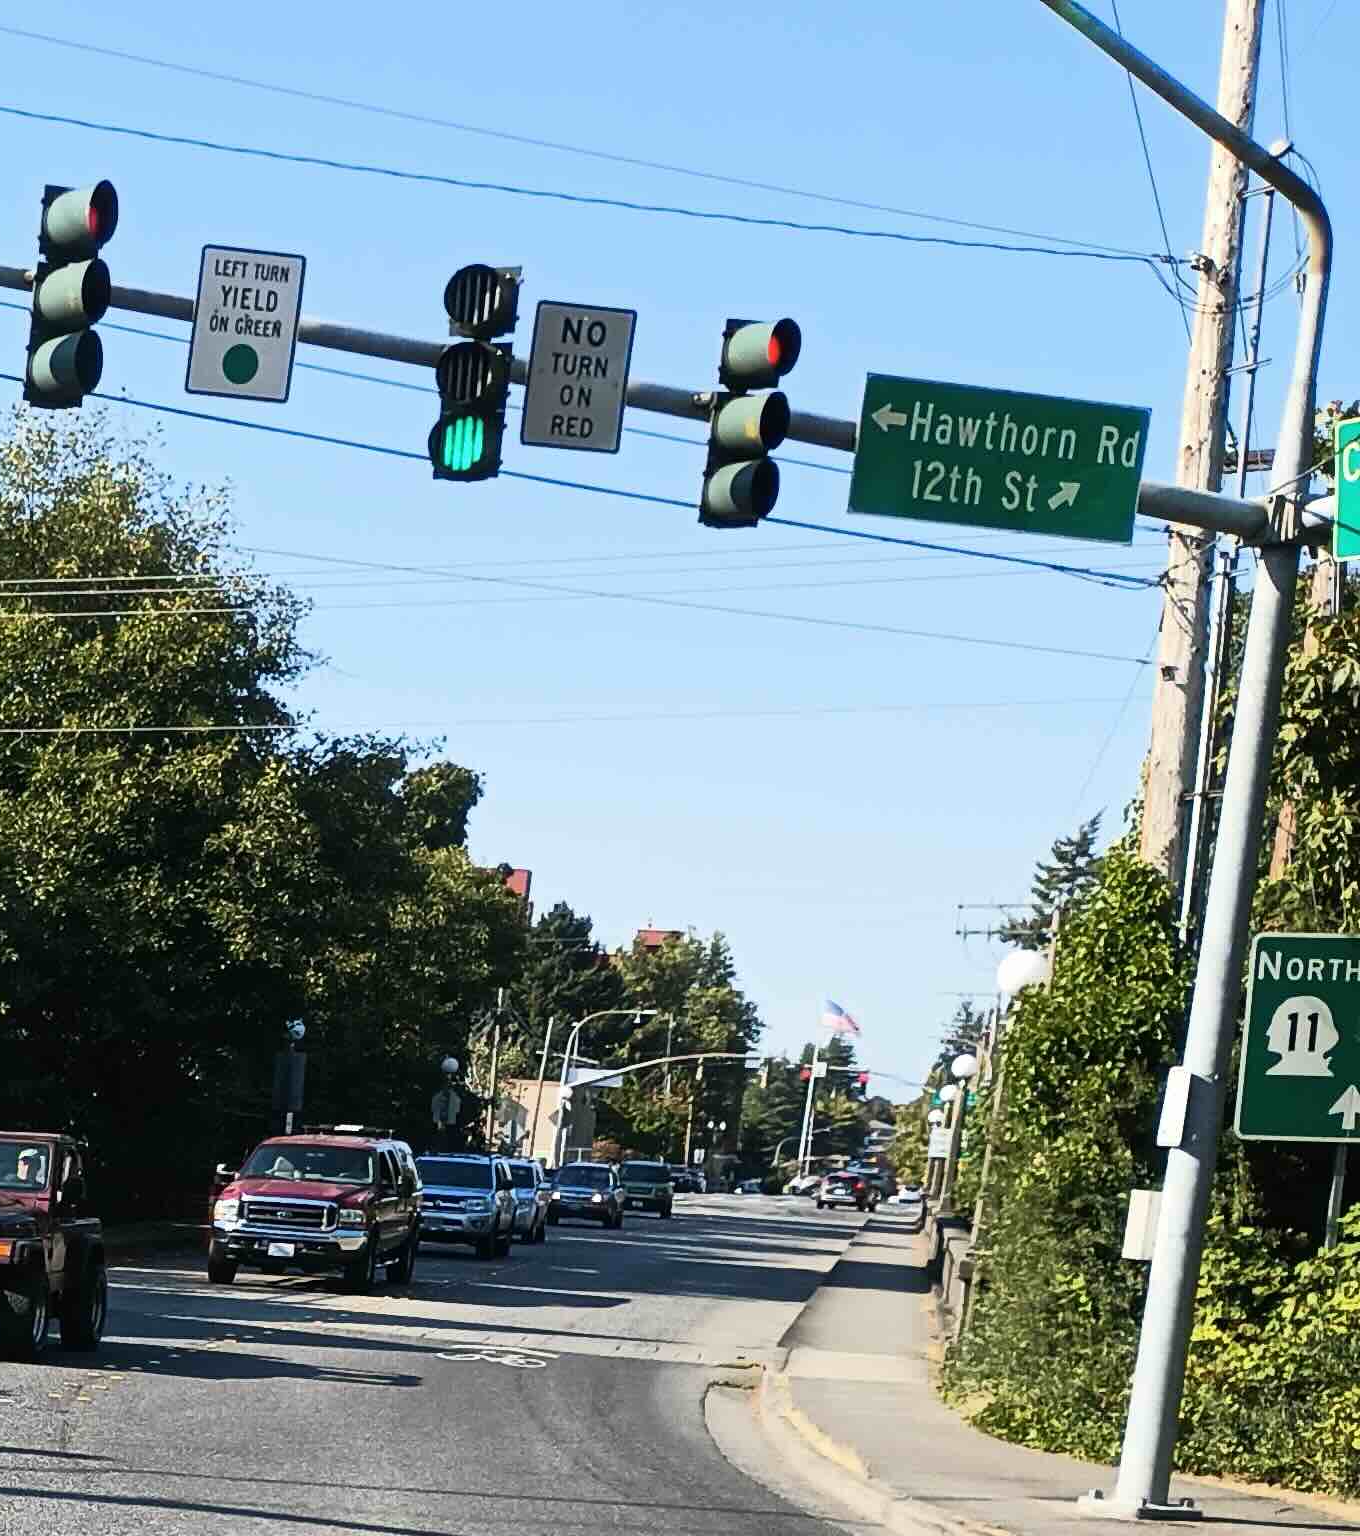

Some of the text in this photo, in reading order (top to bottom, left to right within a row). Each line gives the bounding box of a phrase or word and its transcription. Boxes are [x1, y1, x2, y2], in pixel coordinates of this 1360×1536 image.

[214, 258, 290, 283] LEFT TURN
[221, 285, 278, 312] YIELD
[209, 313, 282, 338] ON GREEN
[561, 317, 607, 347] NO
[551, 352, 609, 379] TURN
[559, 384, 592, 408] ON
[550, 415, 593, 438] RED
[909, 400, 1140, 469] Hawthorn Rd
[911, 459, 1039, 513] 12th St
[1257, 951, 1360, 982] NORTH
[1287, 1012, 1319, 1052] 11
